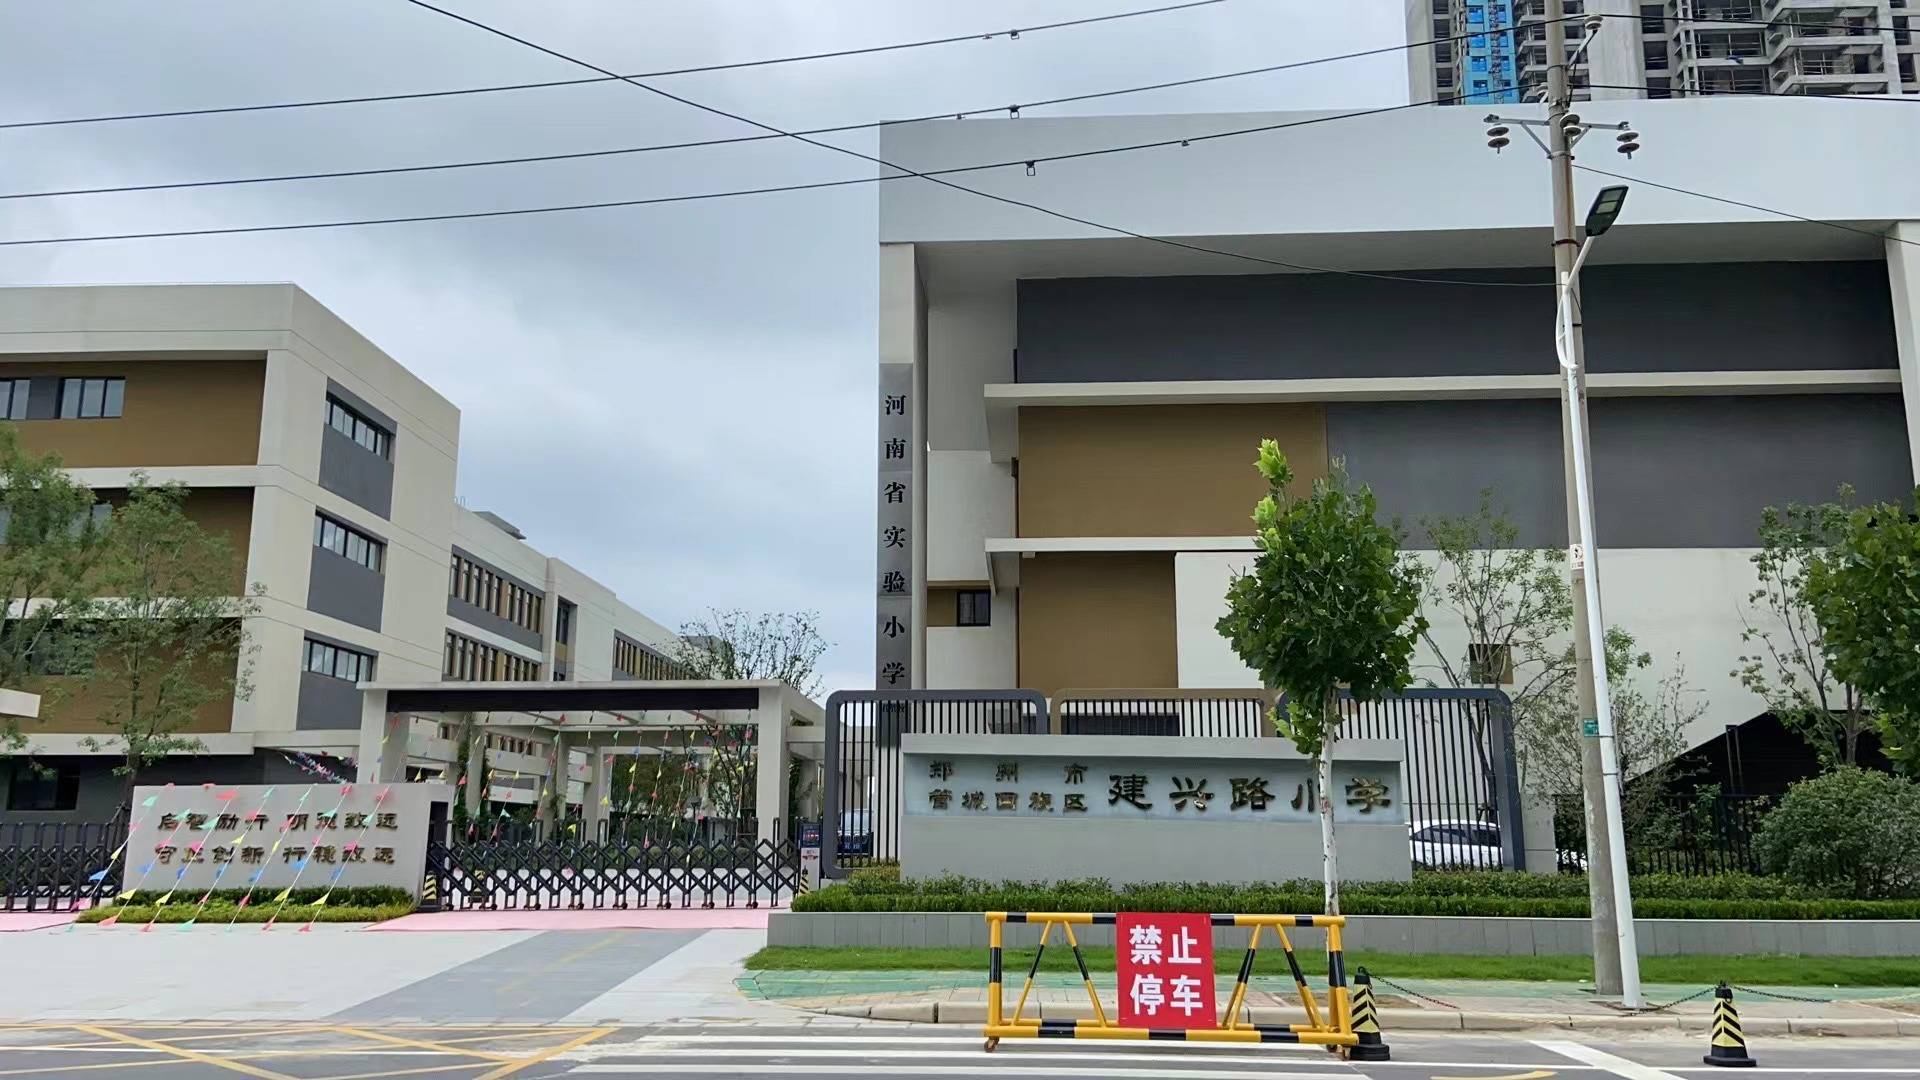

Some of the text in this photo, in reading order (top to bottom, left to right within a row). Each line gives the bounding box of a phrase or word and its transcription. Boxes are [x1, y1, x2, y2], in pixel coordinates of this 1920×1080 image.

[883, 393, 907, 685] 河南省实验小学
[929, 760, 1088, 785] 郑州市
[929, 789, 1088, 812] 管城回族区
[1108, 774, 1391, 813] 建兴路小学
[1129, 925, 1202, 965] 禁止
[1129, 973, 1203, 1016] 停车
